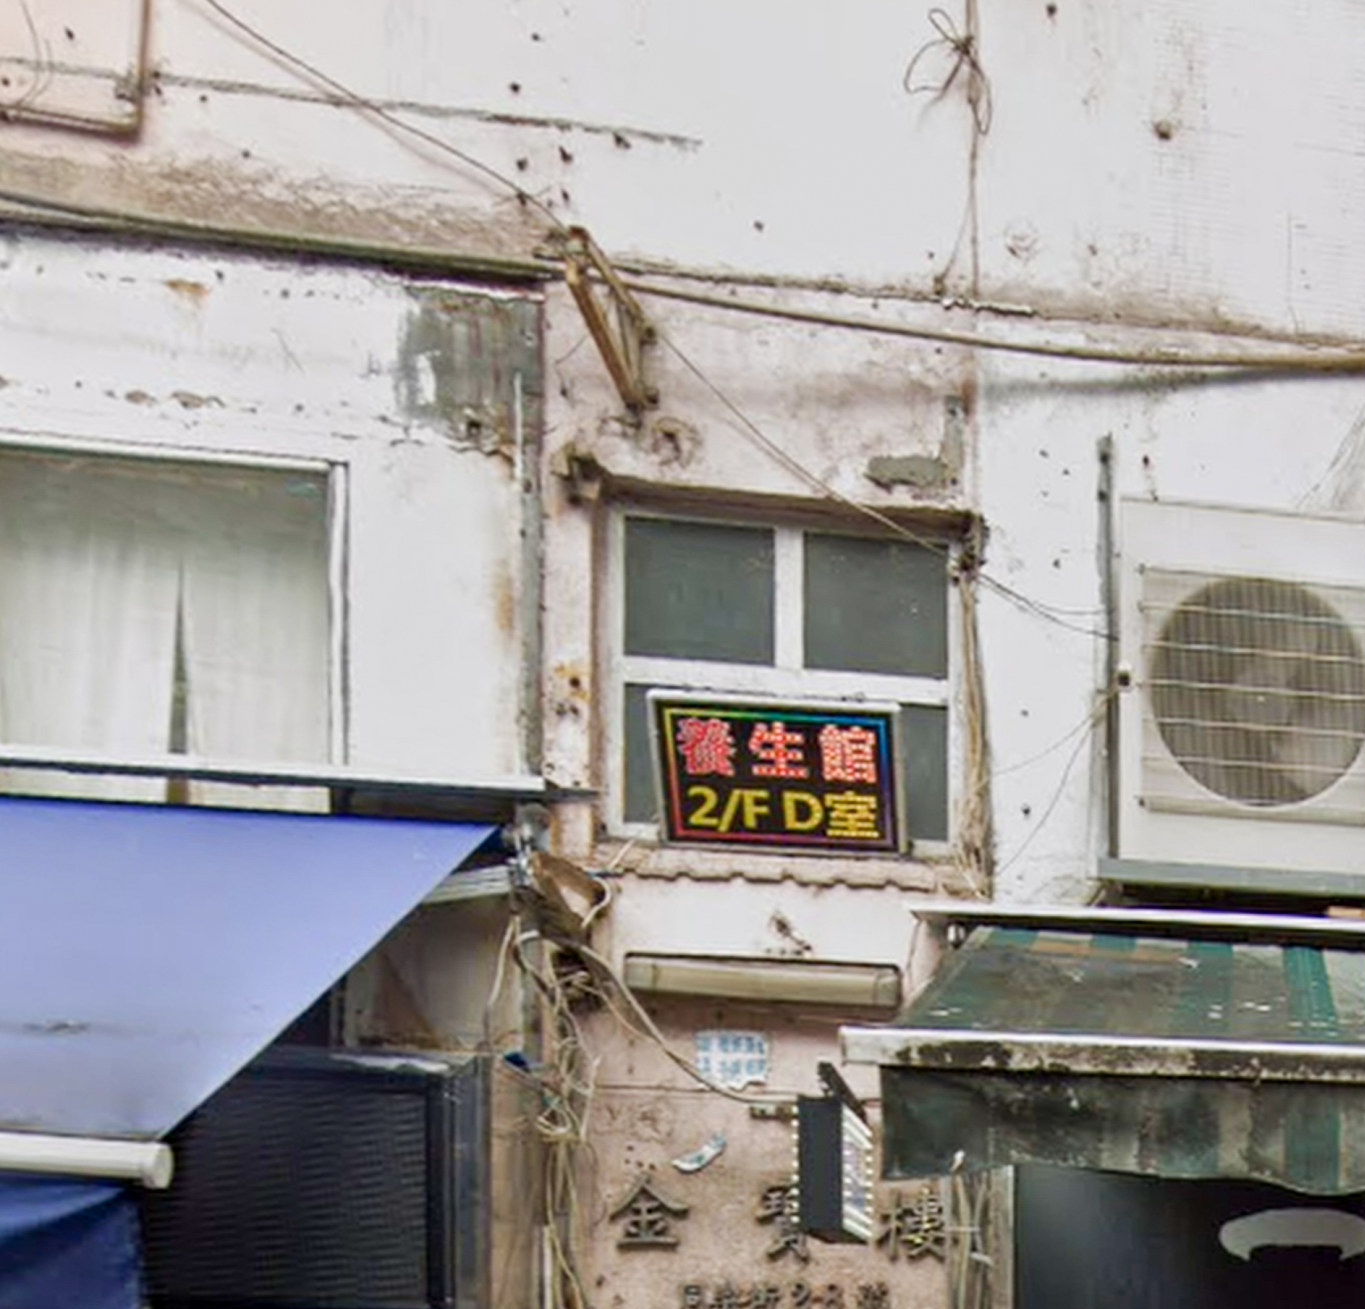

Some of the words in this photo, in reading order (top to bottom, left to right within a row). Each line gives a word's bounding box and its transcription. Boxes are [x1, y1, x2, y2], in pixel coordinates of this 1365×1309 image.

[676, 717, 878, 784] 養生館
[686, 785, 771, 833] 2/F
[782, 790, 880, 838] D室
